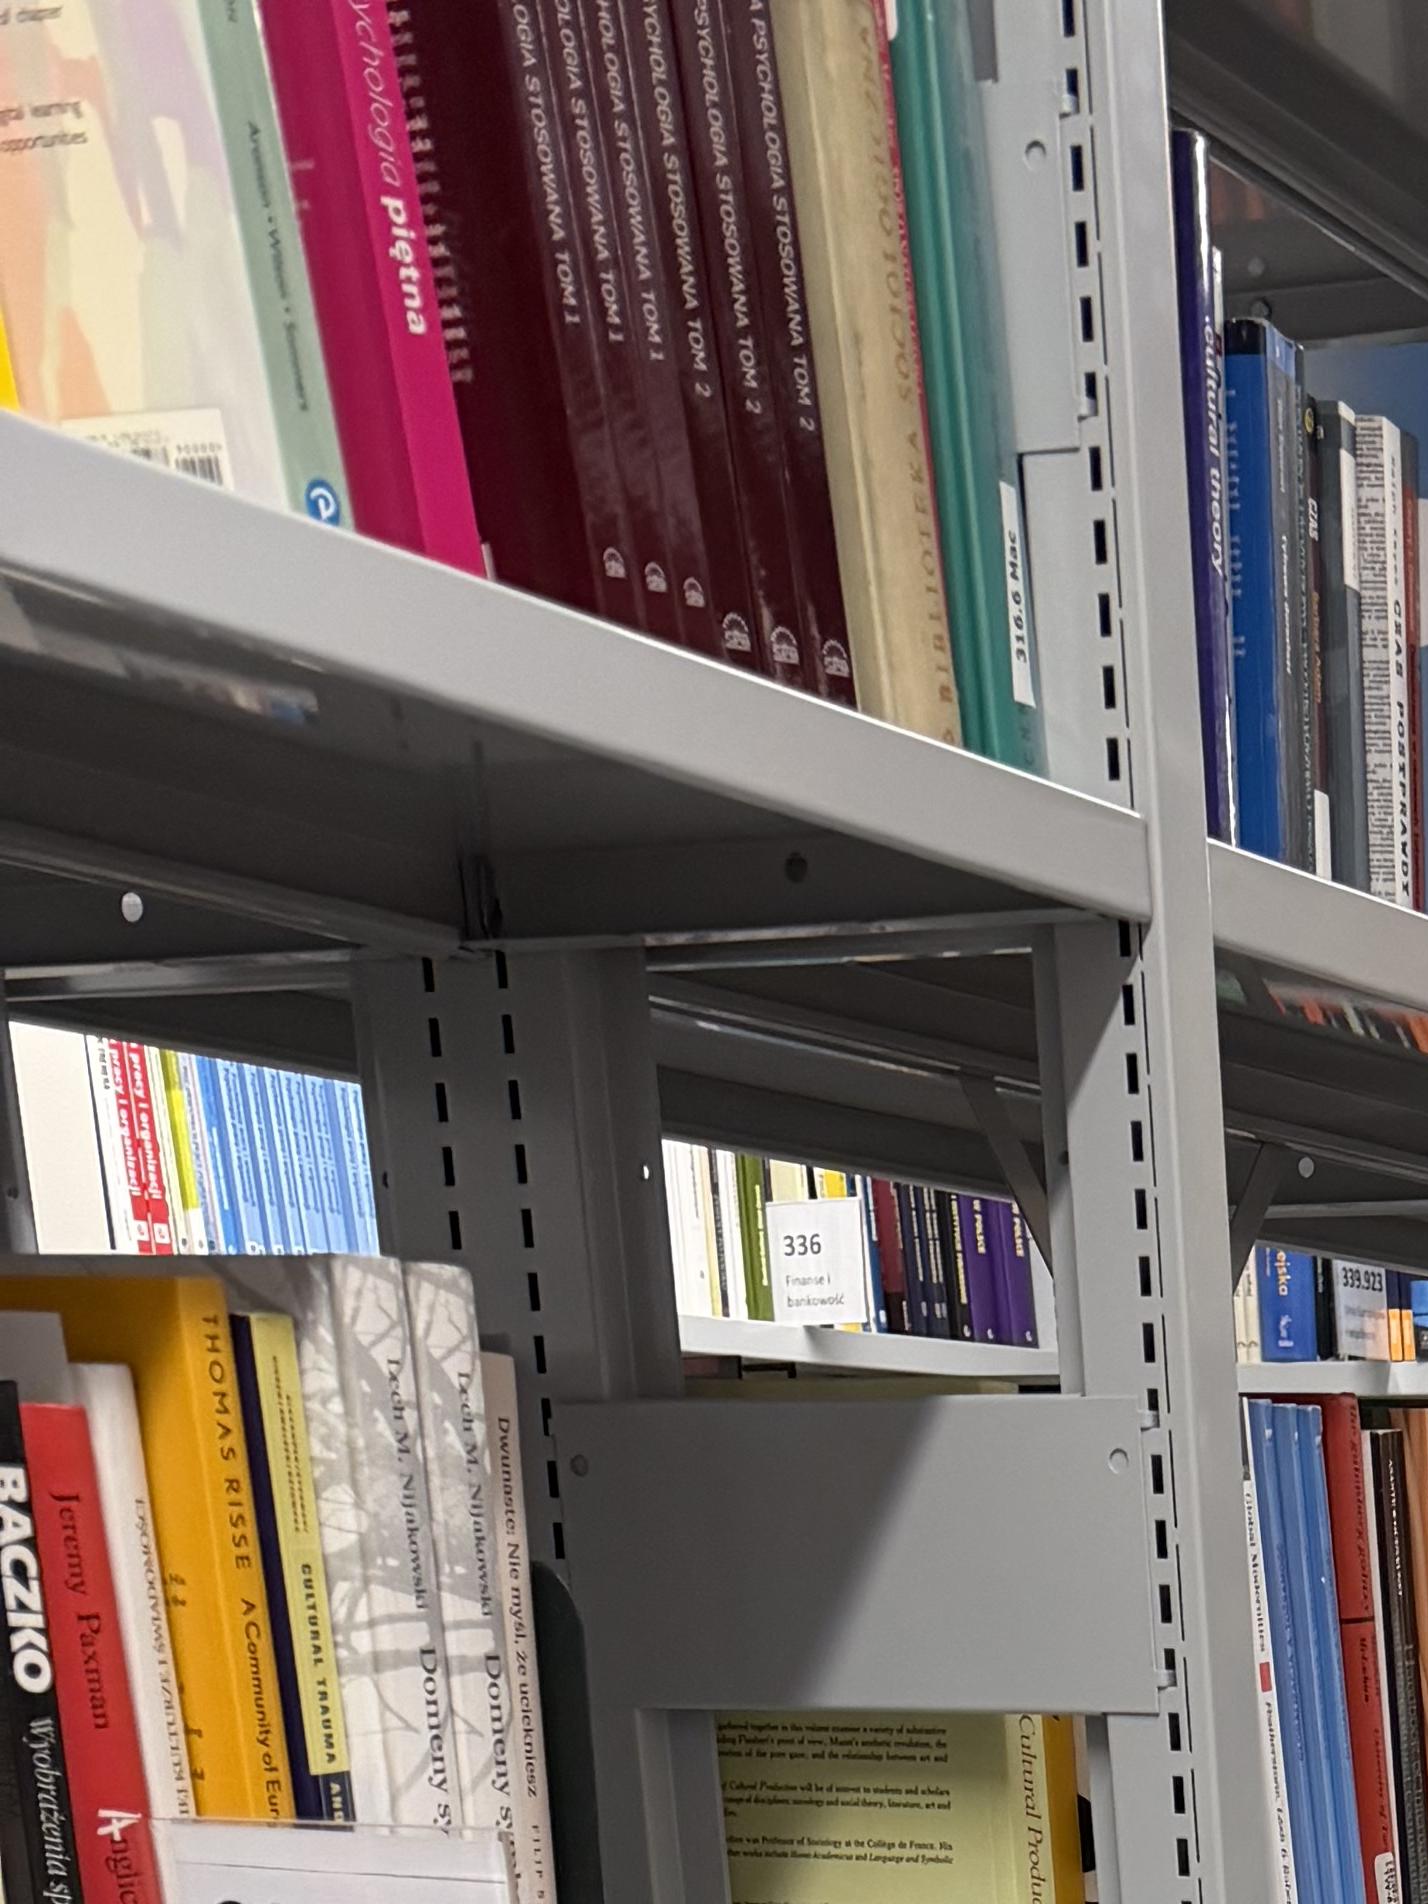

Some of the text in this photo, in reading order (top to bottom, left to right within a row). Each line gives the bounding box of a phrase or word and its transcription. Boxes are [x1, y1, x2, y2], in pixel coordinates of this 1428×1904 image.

[352, 0, 427, 337] ychologia piętna
[752, 18, 815, 431] PSYCHOLOGIA STOSOWANA TOM 2
[1010, 591, 1028, 665] 316.6
[783, 1233, 822, 1257] 336
[786, 1274, 825, 1287] Finanse
[1341, 1266, 1384, 1292] 339.923
[202, 1315, 236, 1473] THOMAS
[225, 1477, 252, 1570] RISSE
[46, 1491, 87, 1597] Jeremy
[77, 1611, 111, 1731] Paxman
[240, 1599, 256, 1617] A
[241, 1620, 273, 1750] Community
[300, 1564, 337, 1766] CULTURAL TRAUMA
[1019, 1713, 1042, 1820] Cultural
